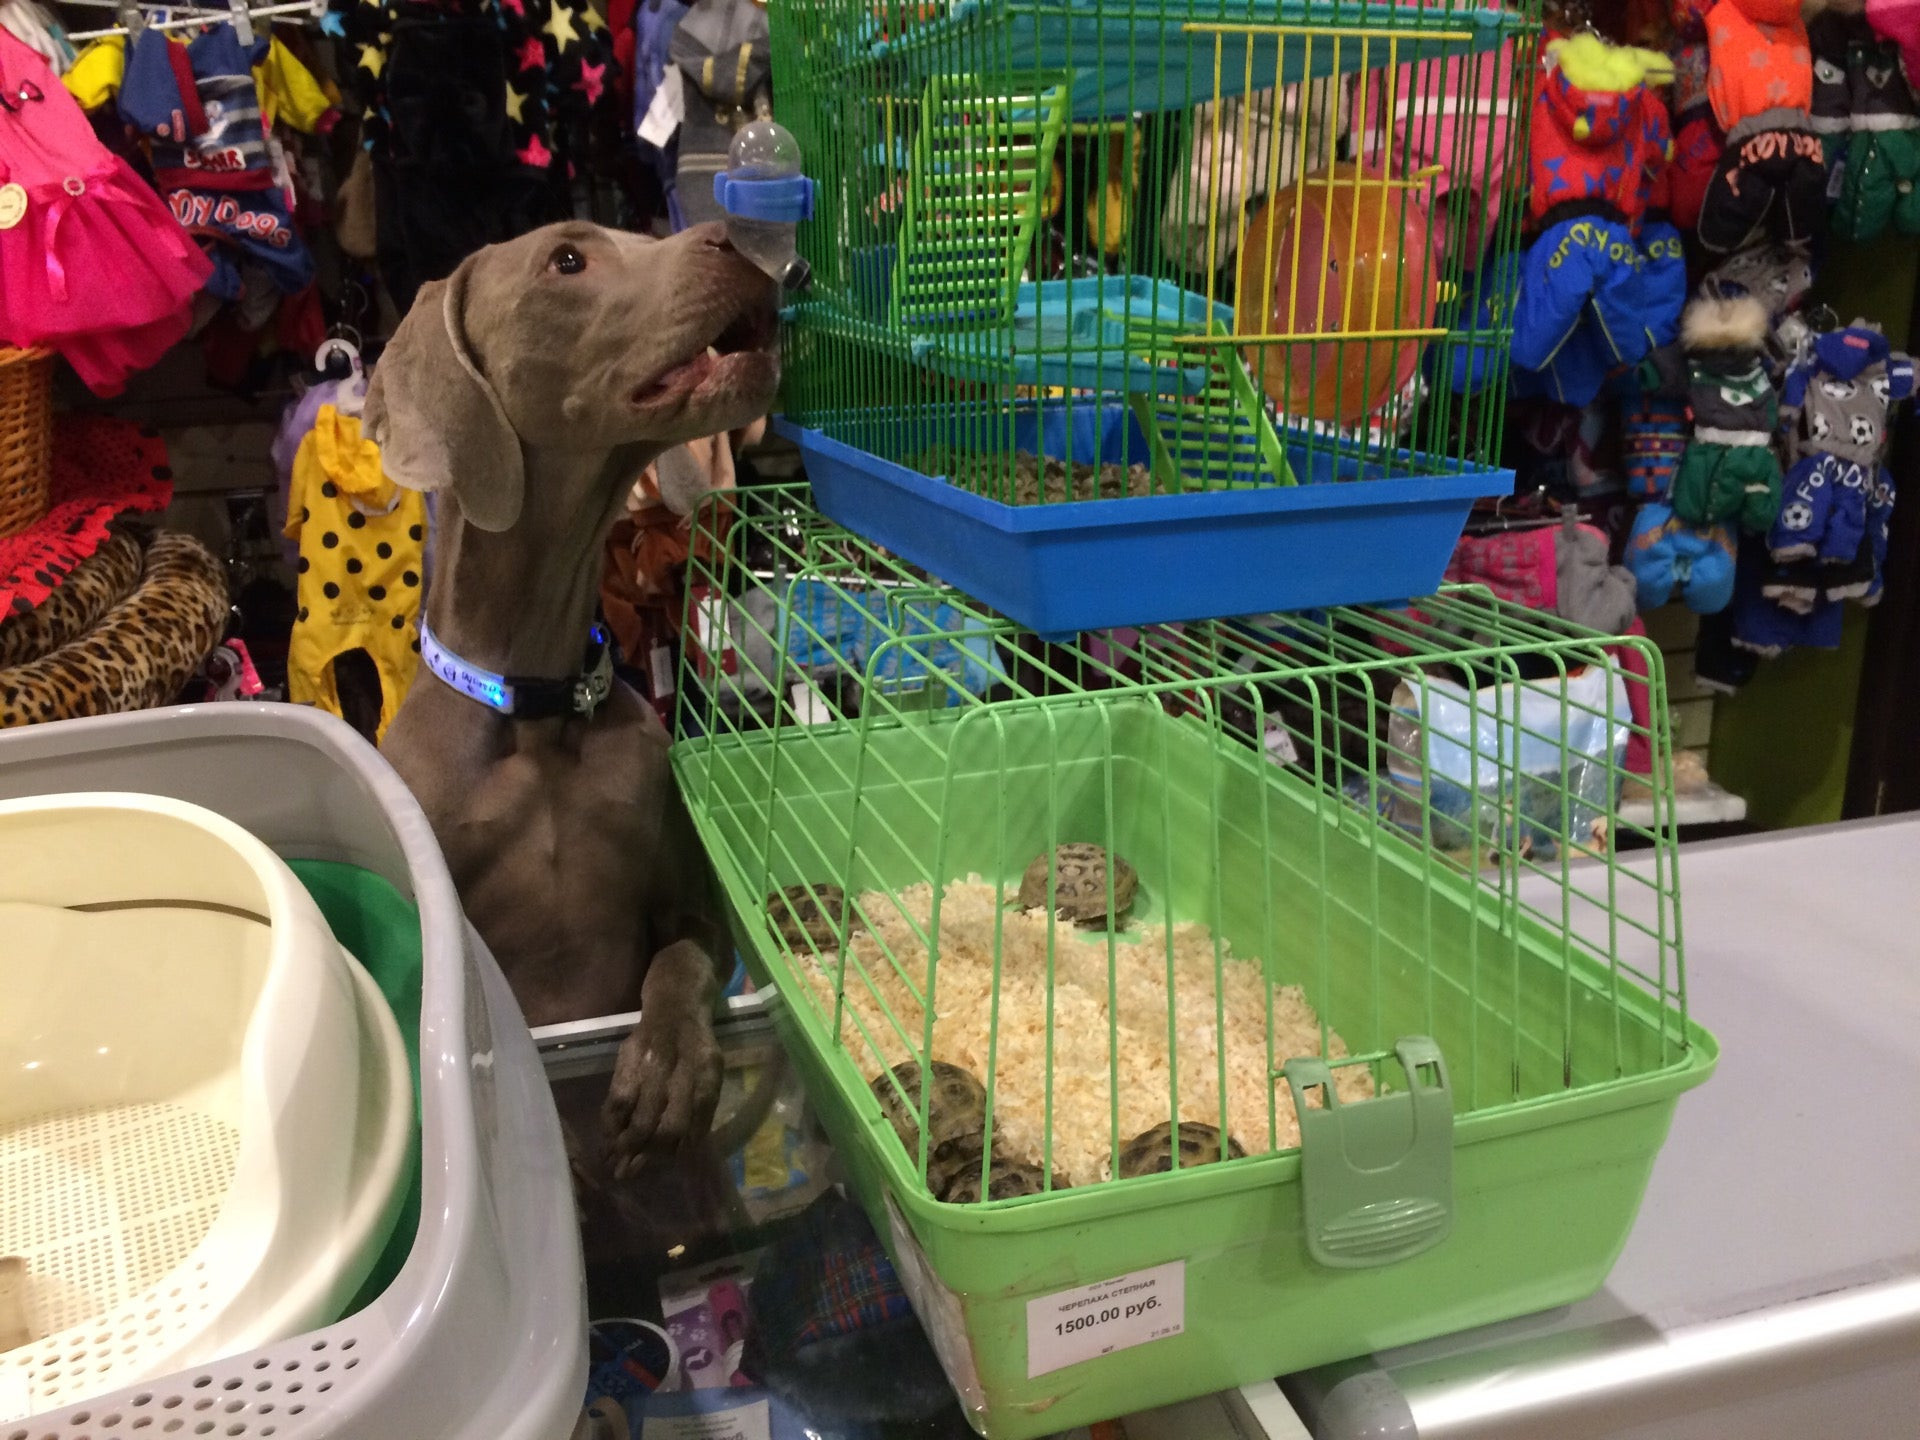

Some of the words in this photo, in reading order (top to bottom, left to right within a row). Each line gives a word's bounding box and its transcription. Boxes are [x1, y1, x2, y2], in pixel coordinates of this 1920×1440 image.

[1058, 1293, 1109, 1313] ЧЕРЕПАХА
[1111, 1279, 1156, 1298] СТЕПНАЯ
[1055, 1306, 1120, 1336] 1500.00
[1125, 1295, 1162, 1319] руб.
